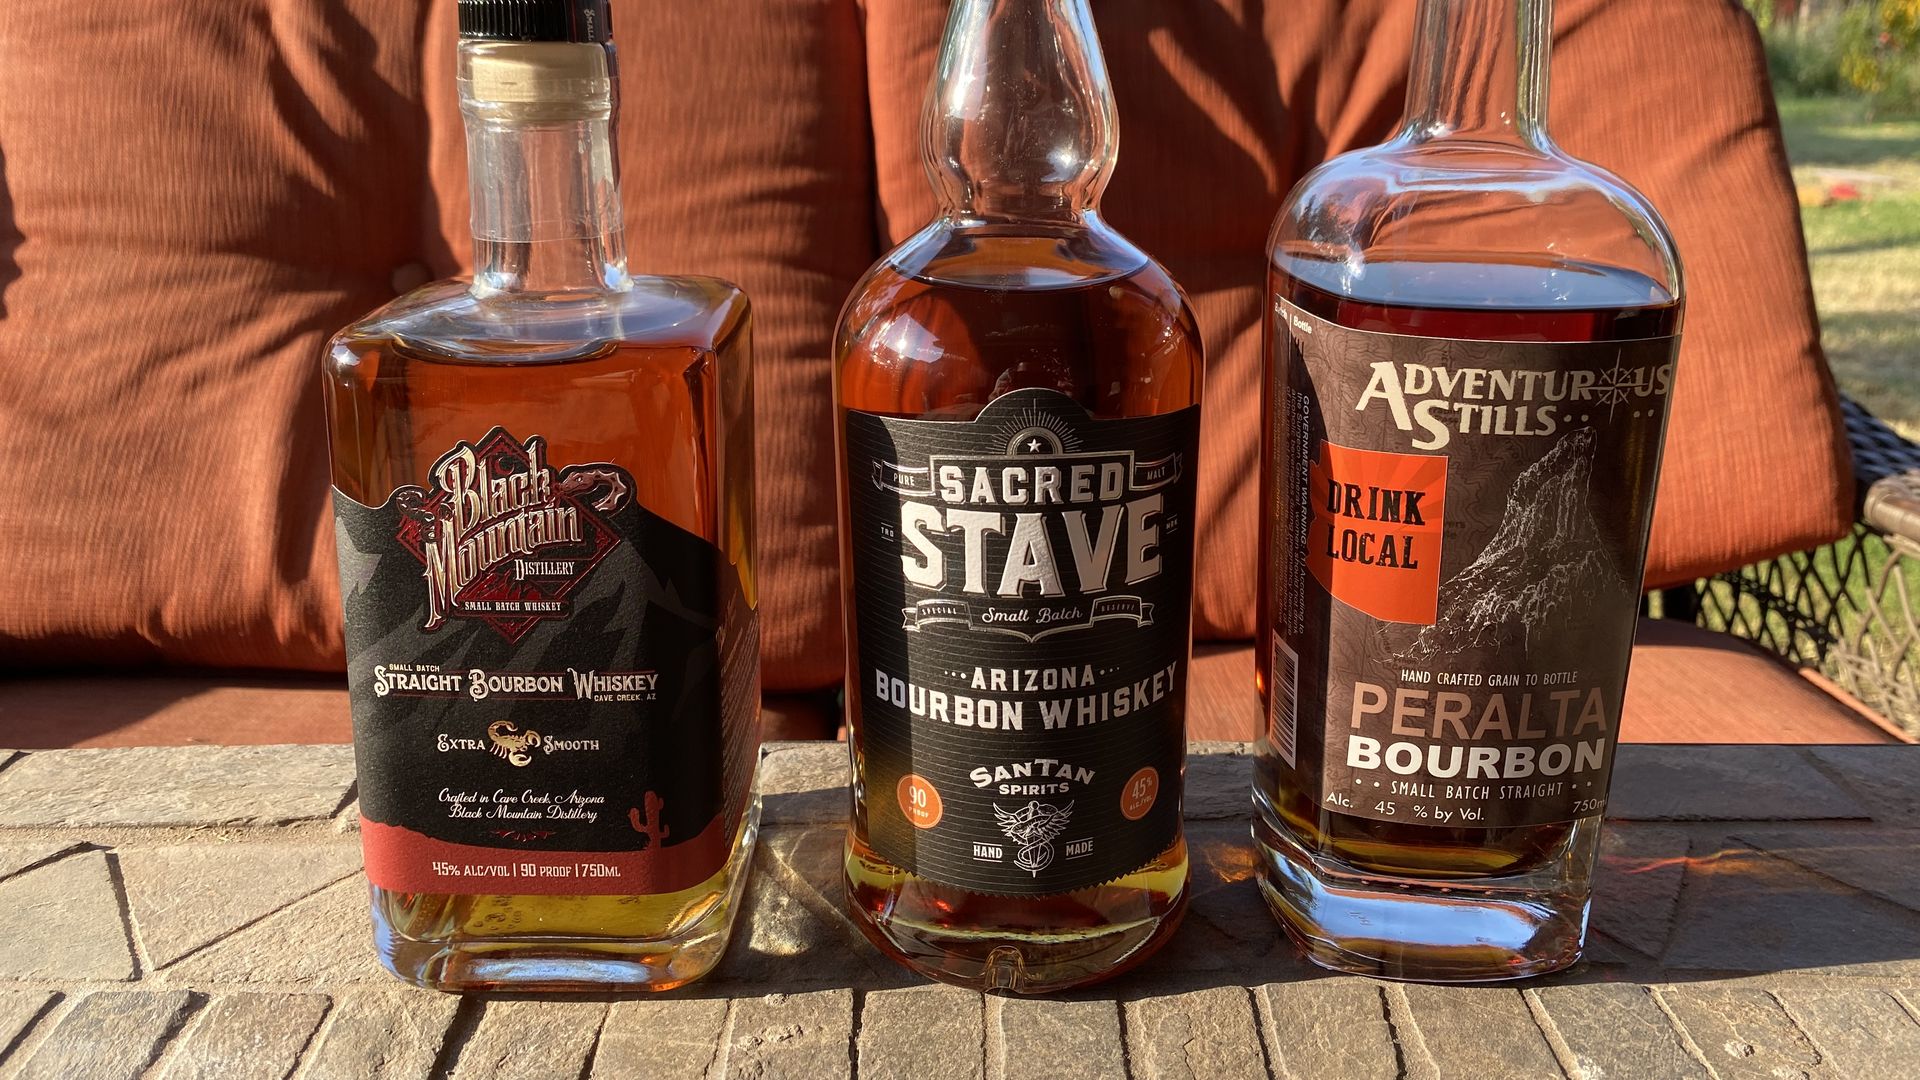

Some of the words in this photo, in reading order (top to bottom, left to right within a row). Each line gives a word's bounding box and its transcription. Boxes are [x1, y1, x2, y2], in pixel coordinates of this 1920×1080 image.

[1293, 315, 1312, 334] Bottle
[1411, 398, 1557, 451] STILLS
[1302, 395, 1310, 485] GOVERNMENT
[893, 472, 915, 487] PURE
[939, 462, 1125, 505] SACRED
[1146, 465, 1166, 482] MALT
[437, 440, 554, 536] Black
[1326, 478, 1427, 527] DRINK
[1300, 487, 1308, 548] WARNING:
[900, 493, 1164, 598] STAVE
[1326, 525, 1419, 570] LOCAL
[422, 504, 584, 628] Mountain
[514, 559, 576, 581] DISTILLERY
[464, 600, 492, 612] SMALL
[495, 601, 521, 612] BATCH
[523, 601, 562, 612] WHISKEY
[921, 606, 957, 616] SPECIAL
[982, 606, 1030, 623] Small
[1035, 606, 1083, 624] Batch
[1101, 603, 1136, 613] RESERVE
[389, 664, 413, 673] SMALL
[416, 664, 440, 673] BATCH
[971, 664, 1096, 692] ARIZONA
[1400, 668, 1431, 684] HAND
[1437, 671, 1480, 687] CRAFTED
[1488, 673, 1519, 687] GRAIN
[1525, 673, 1539, 686] TO
[1543, 670, 1578, 686] BOTTLE
[373, 665, 462, 698] STRAIGHT
[468, 669, 564, 702] BOURBON
[566, 667, 659, 701] WHISKEY
[594, 693, 614, 702] CAVE
[646, 693, 657, 701] AZ
[875, 668, 1023, 731] BOURBON
[1038, 660, 1178, 730] WHISKEY
[1350, 681, 1607, 741] PERALTA
[437, 732, 487, 752] EXTRA
[543, 735, 600, 755] SMOOTH
[1346, 734, 1606, 780] BOURBON
[438, 788, 477, 809] Crafted
[479, 790, 490, 804] in
[492, 788, 518, 805] Cave
[554, 789, 605, 809] Arizona
[909, 785, 926, 808] 90
[999, 782, 1070, 796] SPIRITS
[1390, 781, 1436, 800] SMALL
[1445, 785, 1490, 800] BATCH
[1499, 782, 1564, 800] STRAIGHT
[448, 803, 483, 820] Black
[485, 803, 543, 820] Mountain
[546, 804, 599, 824] Distillery
[1326, 791, 1354, 809] Alc.
[1374, 800, 1396, 816] 45
[1413, 804, 1429, 819] %
[1433, 805, 1453, 824] by
[1459, 807, 1485, 821] Vol.
[973, 844, 1003, 859] HAND
[1065, 840, 1094, 857] MADE
[432, 861, 461, 877] 45%
[463, 864, 510, 878] ALC/VOL
[521, 862, 537, 878] 90
[539, 865, 572, 878] PROOF
